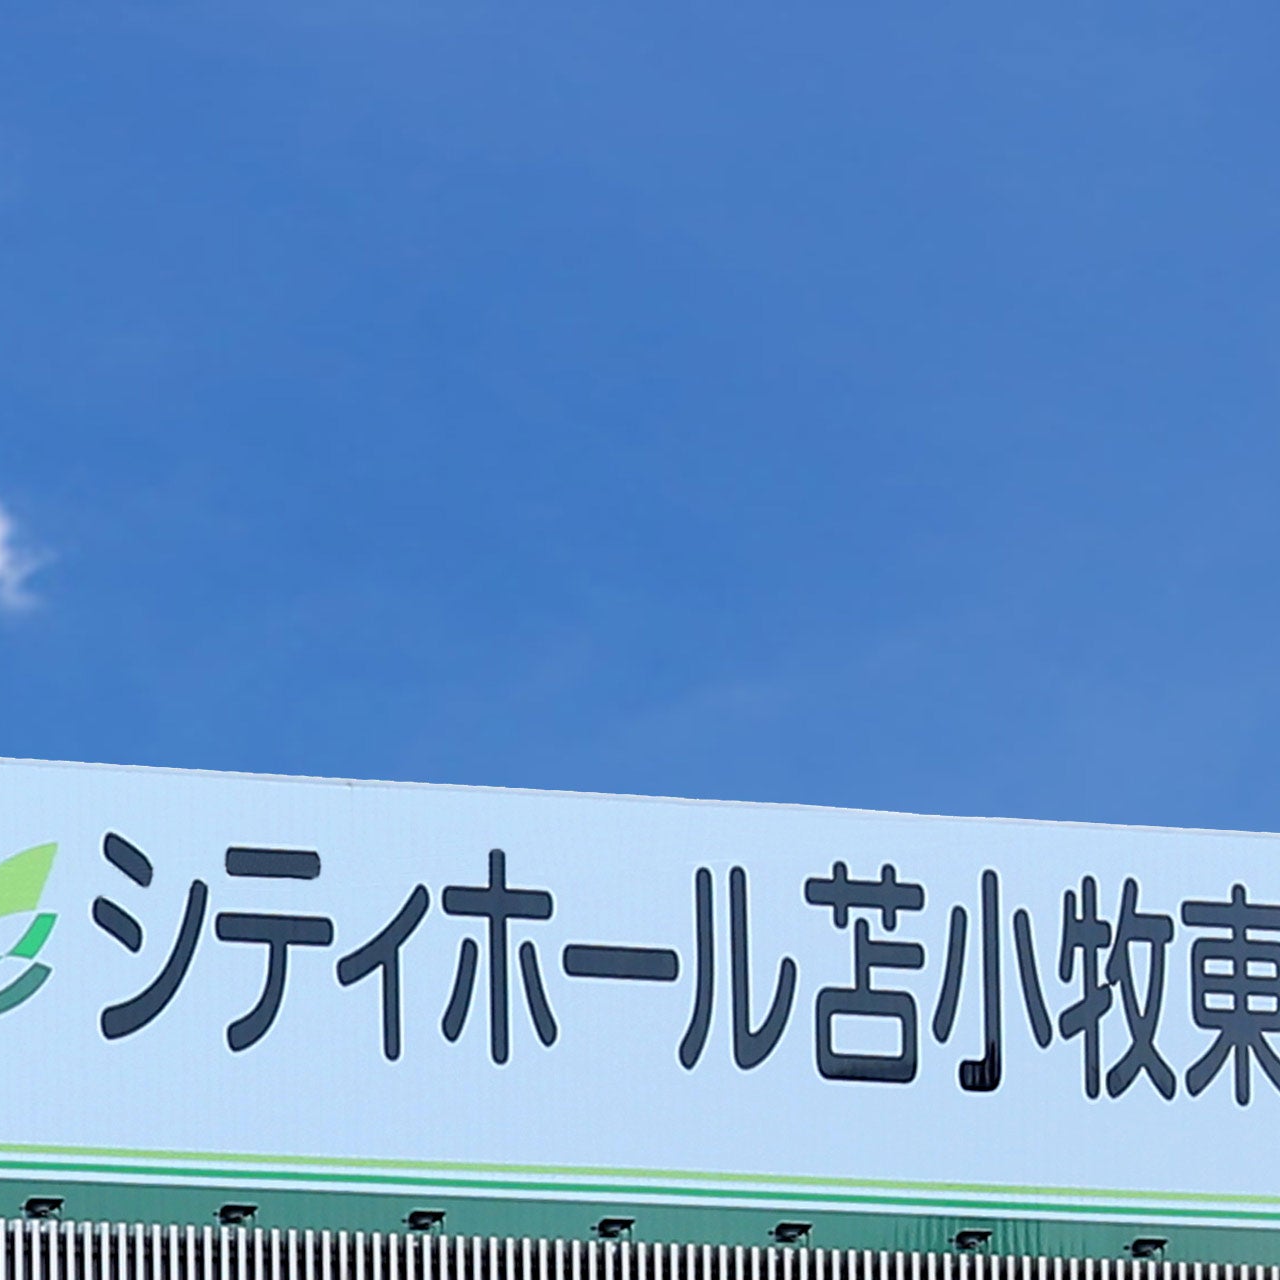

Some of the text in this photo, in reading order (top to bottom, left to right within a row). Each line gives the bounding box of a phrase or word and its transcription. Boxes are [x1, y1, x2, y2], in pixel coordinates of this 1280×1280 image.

[92, 832, 1280, 1106] シティホール苫小牧東
